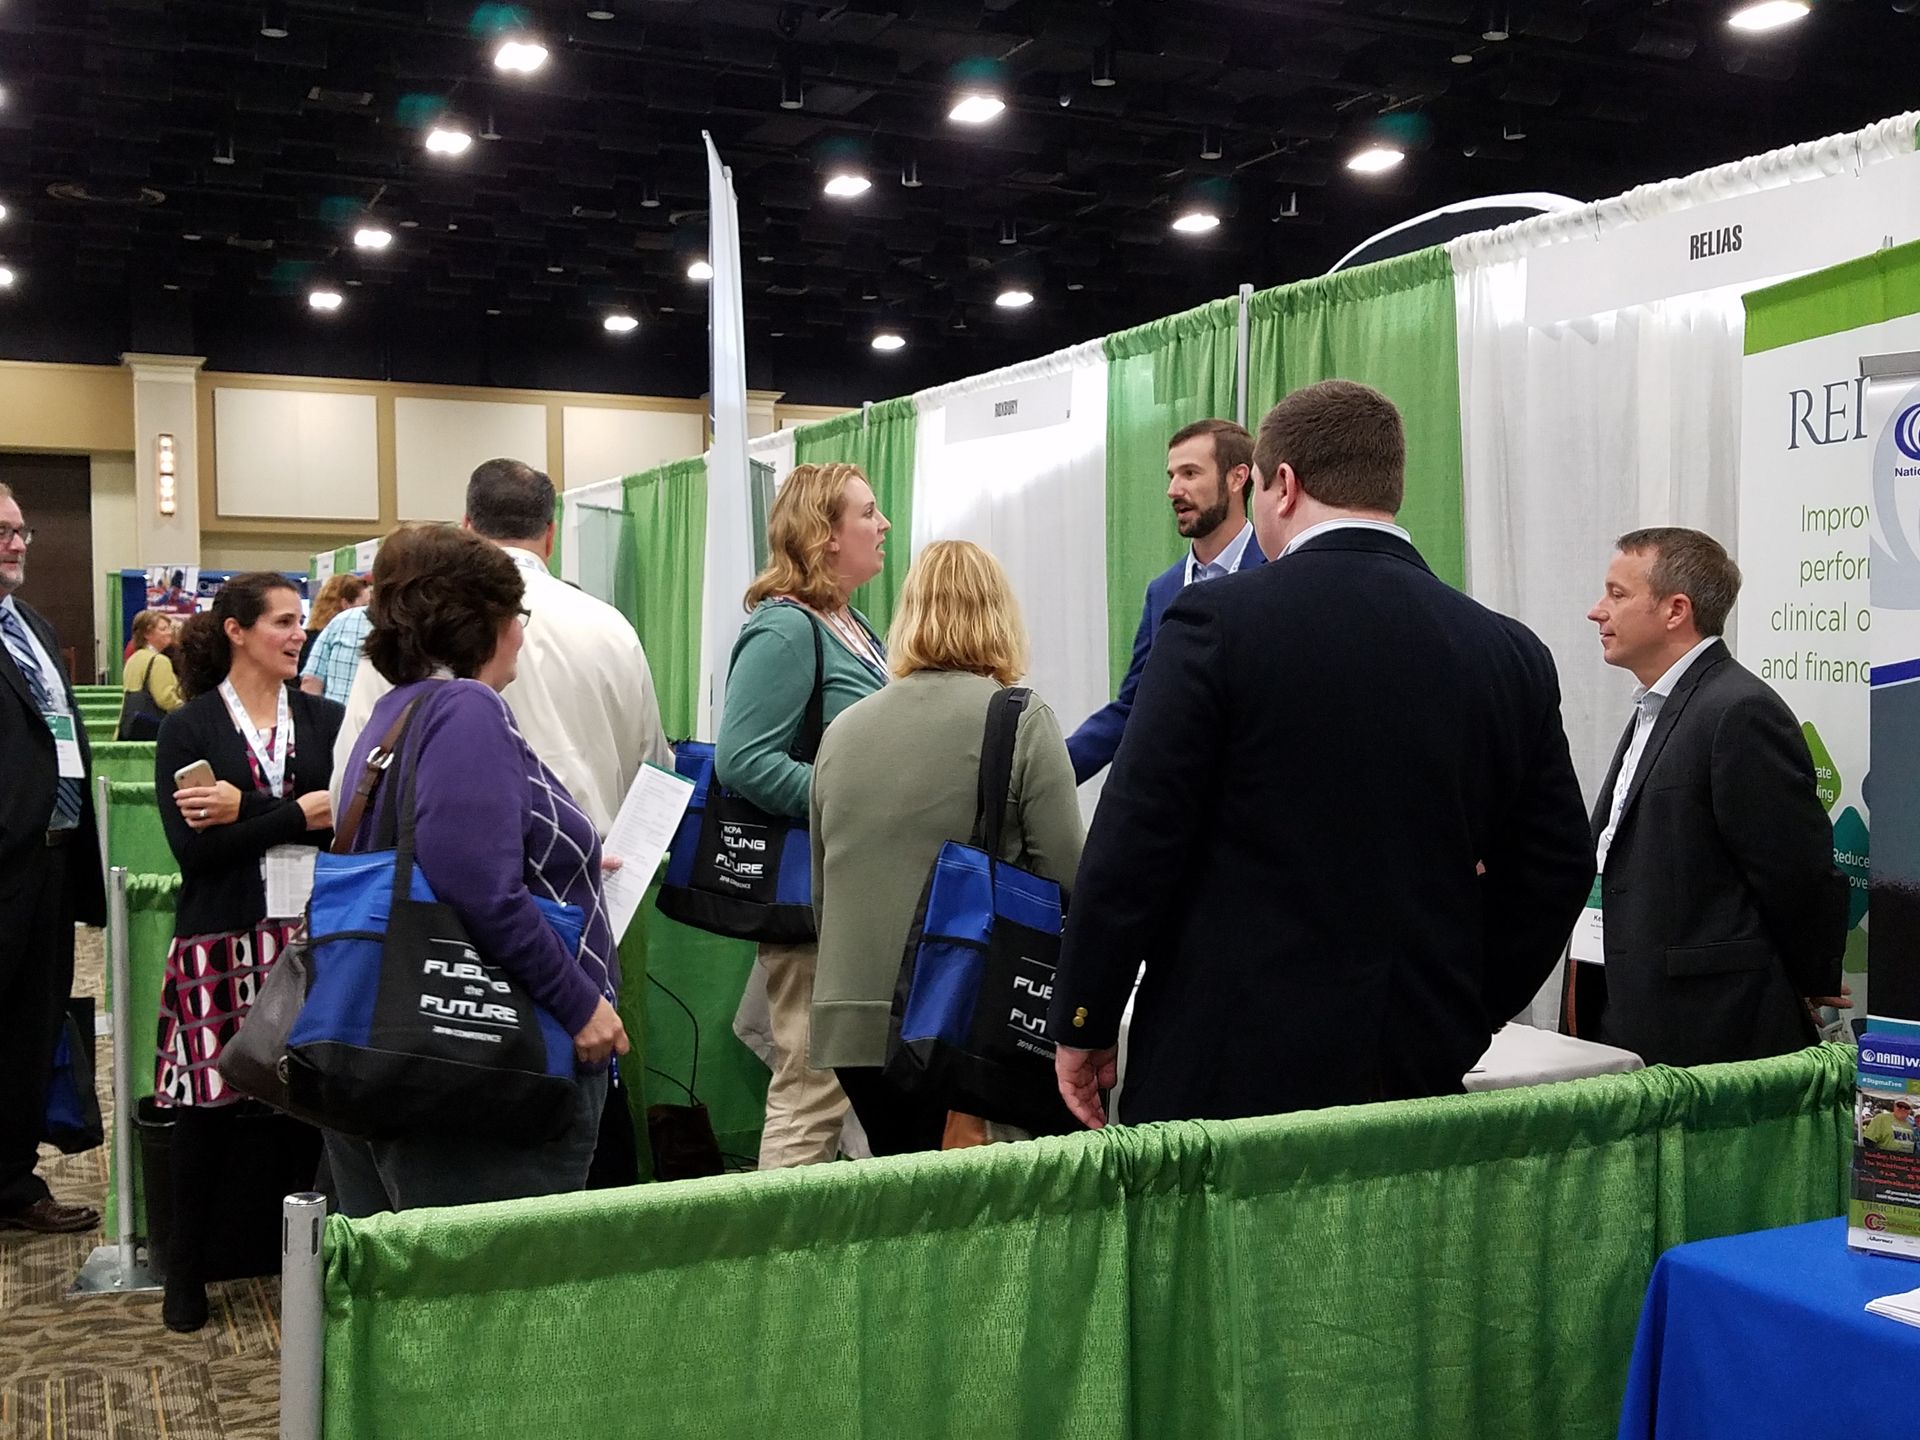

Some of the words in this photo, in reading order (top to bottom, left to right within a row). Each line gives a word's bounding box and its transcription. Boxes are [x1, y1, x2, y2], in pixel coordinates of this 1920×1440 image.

[1690, 224, 1743, 260] RELIAS
[1800, 550, 1870, 588] perfor
[1771, 601, 1847, 632] clinical
[1761, 651, 1798, 680] and
[1833, 848, 1870, 868] Reduce
[420, 993, 519, 1023] FUTURE
